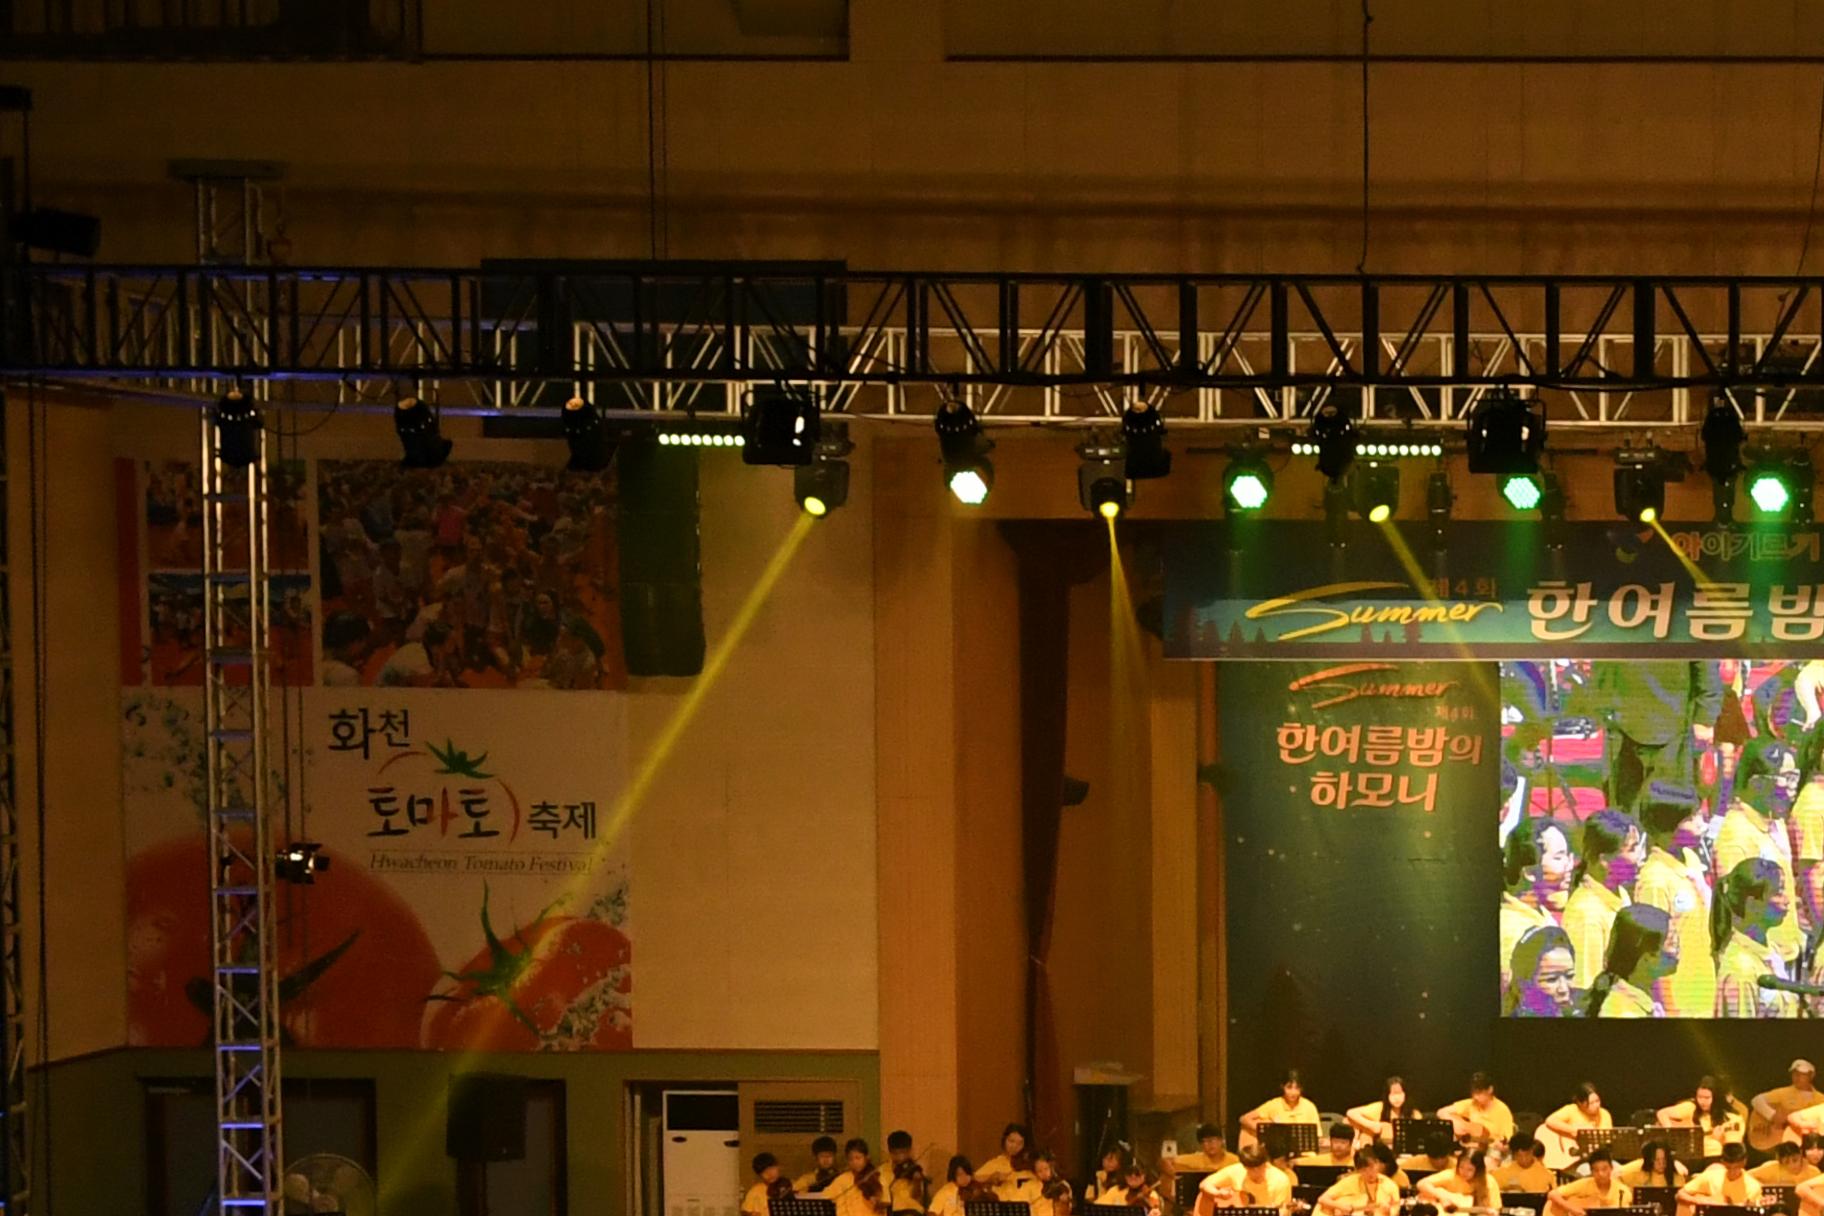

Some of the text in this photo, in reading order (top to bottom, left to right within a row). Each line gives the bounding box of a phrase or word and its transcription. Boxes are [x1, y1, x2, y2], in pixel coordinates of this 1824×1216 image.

[1245, 580, 1503, 640] Summer
[1288, 662, 1461, 710] Summer
[328, 707, 411, 761] 화천
[1276, 722, 1484, 768] 한여름밤의
[365, 786, 597, 840] 토마토 축제
[1310, 771, 1439, 812] 하모니
[464, 853, 526, 871] Tomato
[528, 853, 594, 871] Festival
